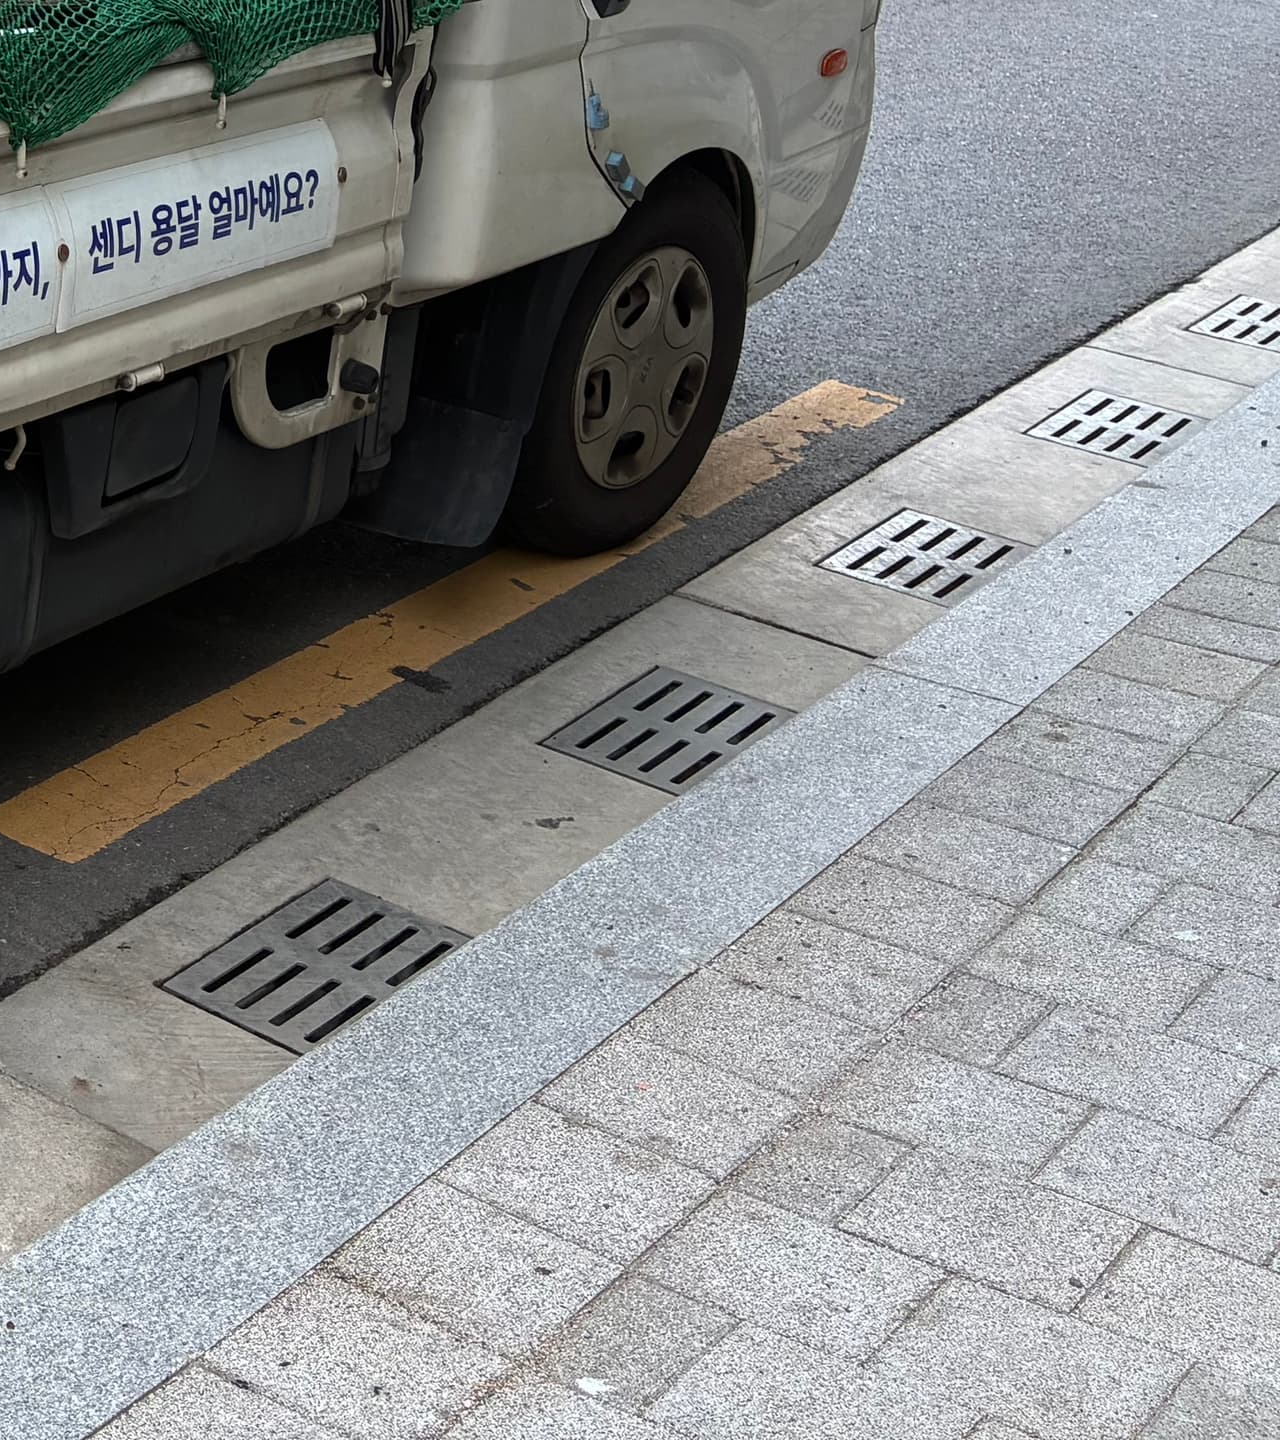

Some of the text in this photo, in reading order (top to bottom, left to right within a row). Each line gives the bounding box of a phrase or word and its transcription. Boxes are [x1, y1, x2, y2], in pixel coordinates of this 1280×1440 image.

[88, 211, 141, 274] 센디
[151, 195, 201, 256] 용달
[208, 168, 318, 240] 얼마예요?
